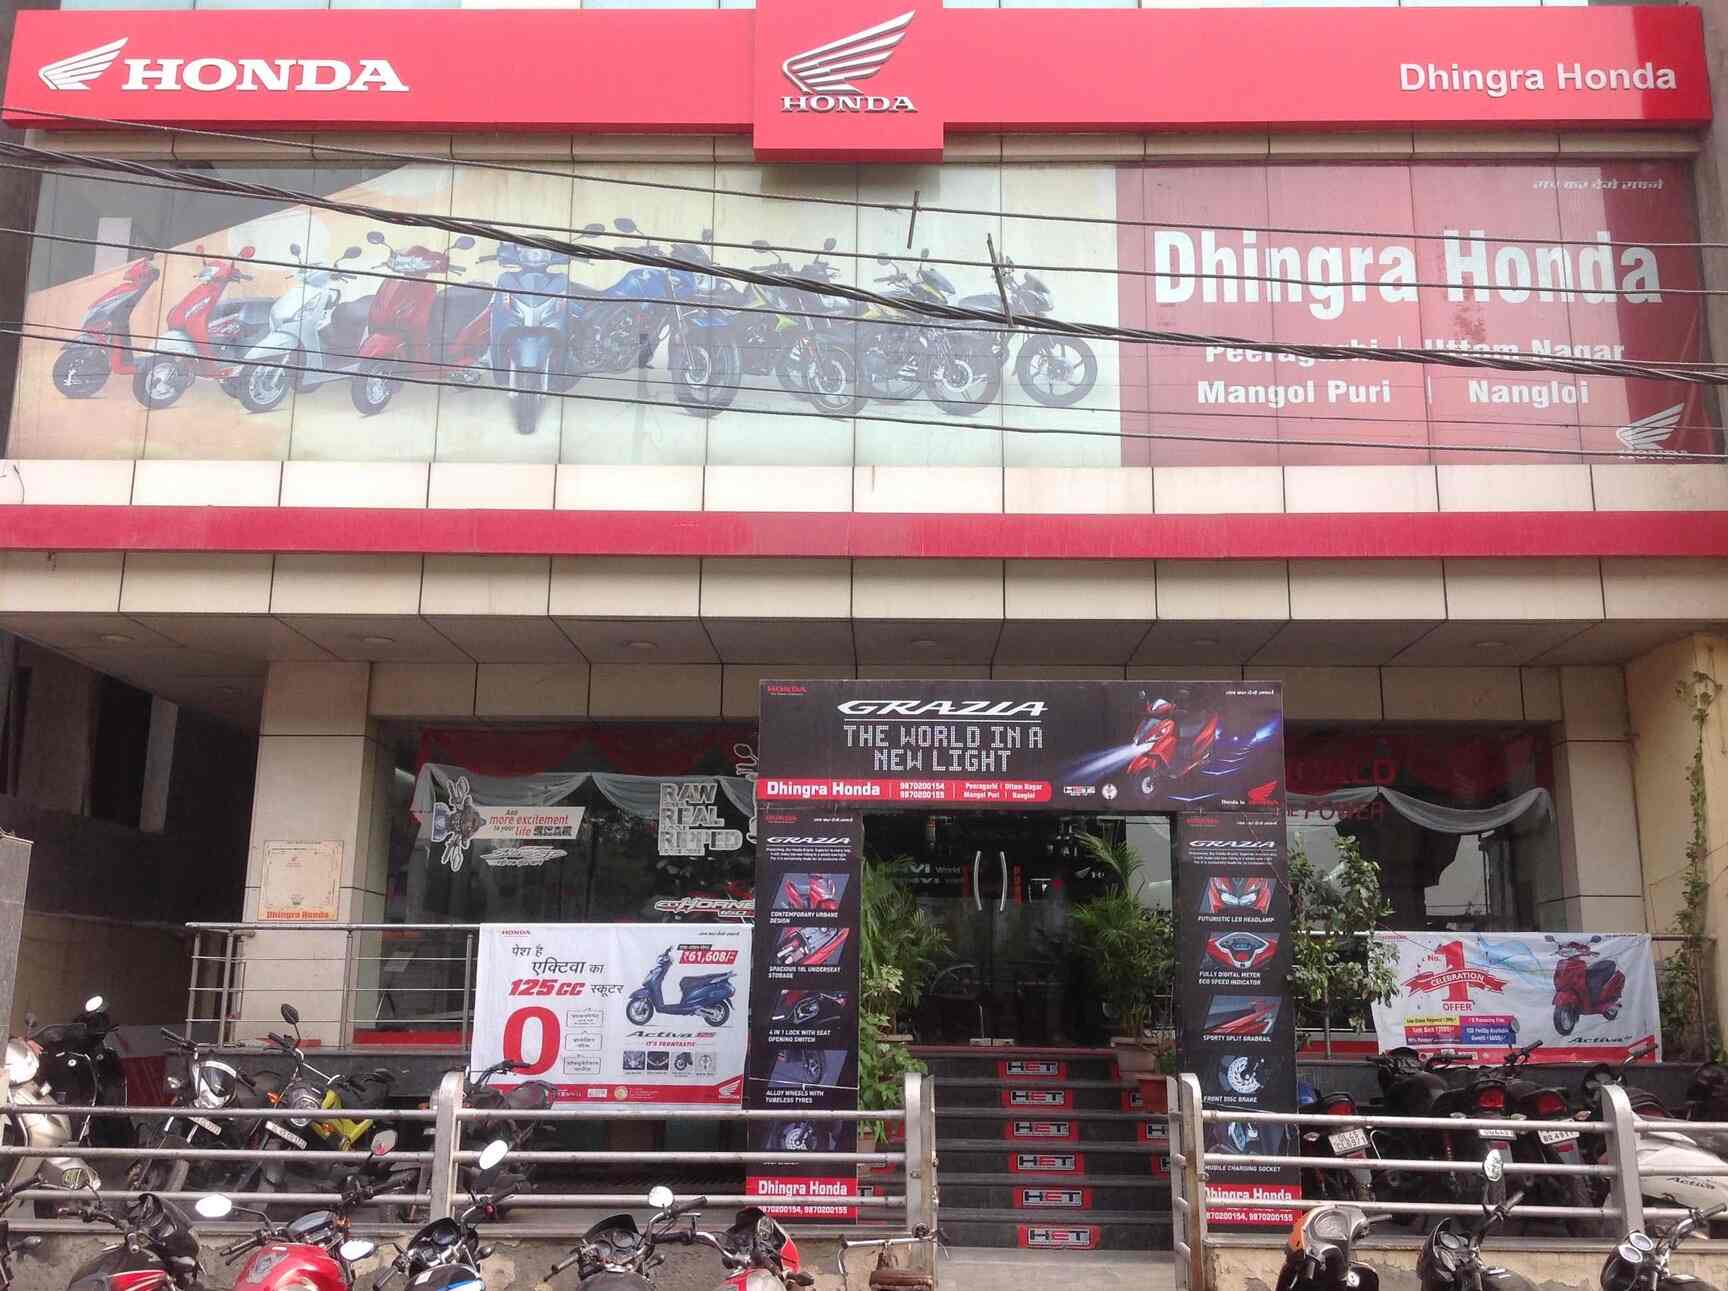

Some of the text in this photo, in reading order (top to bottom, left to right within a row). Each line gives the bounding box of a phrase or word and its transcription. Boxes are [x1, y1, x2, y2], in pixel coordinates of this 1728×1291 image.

[122, 58, 409, 91] HONDA
[1400, 63, 1677, 97] Dhingra Honda
[782, 96, 917, 112] HONDA
[1153, 231, 1662, 319] Dhingra Honda
[1205, 339, 1378, 367] Peerag
[1198, 380, 1589, 408] Mangol Puri Nangloi
[837, 700, 1048, 716] GRAZIA
[843, 725, 1043, 749] THE WORLD IN A
[874, 750, 1011, 772] NEW LIGHT
[660, 783, 718, 803] RAW
[767, 781, 881, 797] Dhingra Honda
[490, 814, 569, 825] more excitement
[514, 826, 531, 836] life
[767, 836, 850, 844] GRAZIA
[1189, 840, 1275, 848] GRAZIA
[532, 956, 604, 976] एक्टिवा का
[509, 978, 559, 996] 125
[1430, 972, 1485, 986] CELEBRATION
[1442, 1002, 1473, 1012] OFFER
[503, 1006, 561, 1075] 0
[758, 1180, 848, 1197] Dhingra Honda
[1252, 1187, 1292, 1200] Honda
